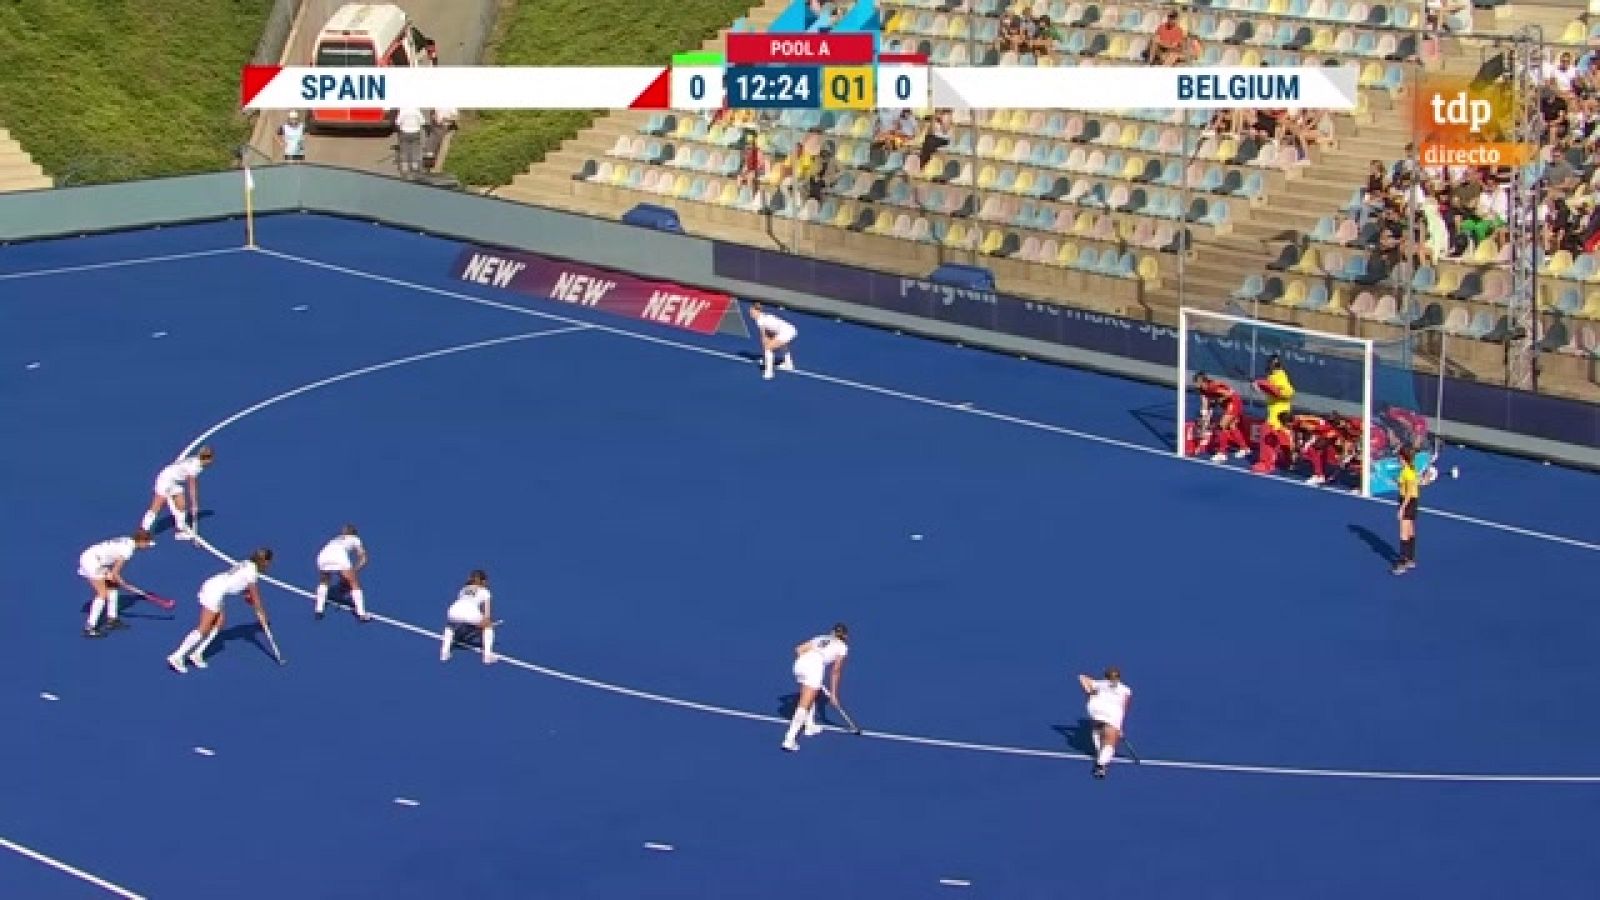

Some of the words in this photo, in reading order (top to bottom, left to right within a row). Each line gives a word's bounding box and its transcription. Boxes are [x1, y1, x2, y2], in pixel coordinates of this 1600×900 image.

[462, 254, 520, 288] NEW
[550, 271, 611, 306] NEW
[640, 290, 704, 328] NEW
